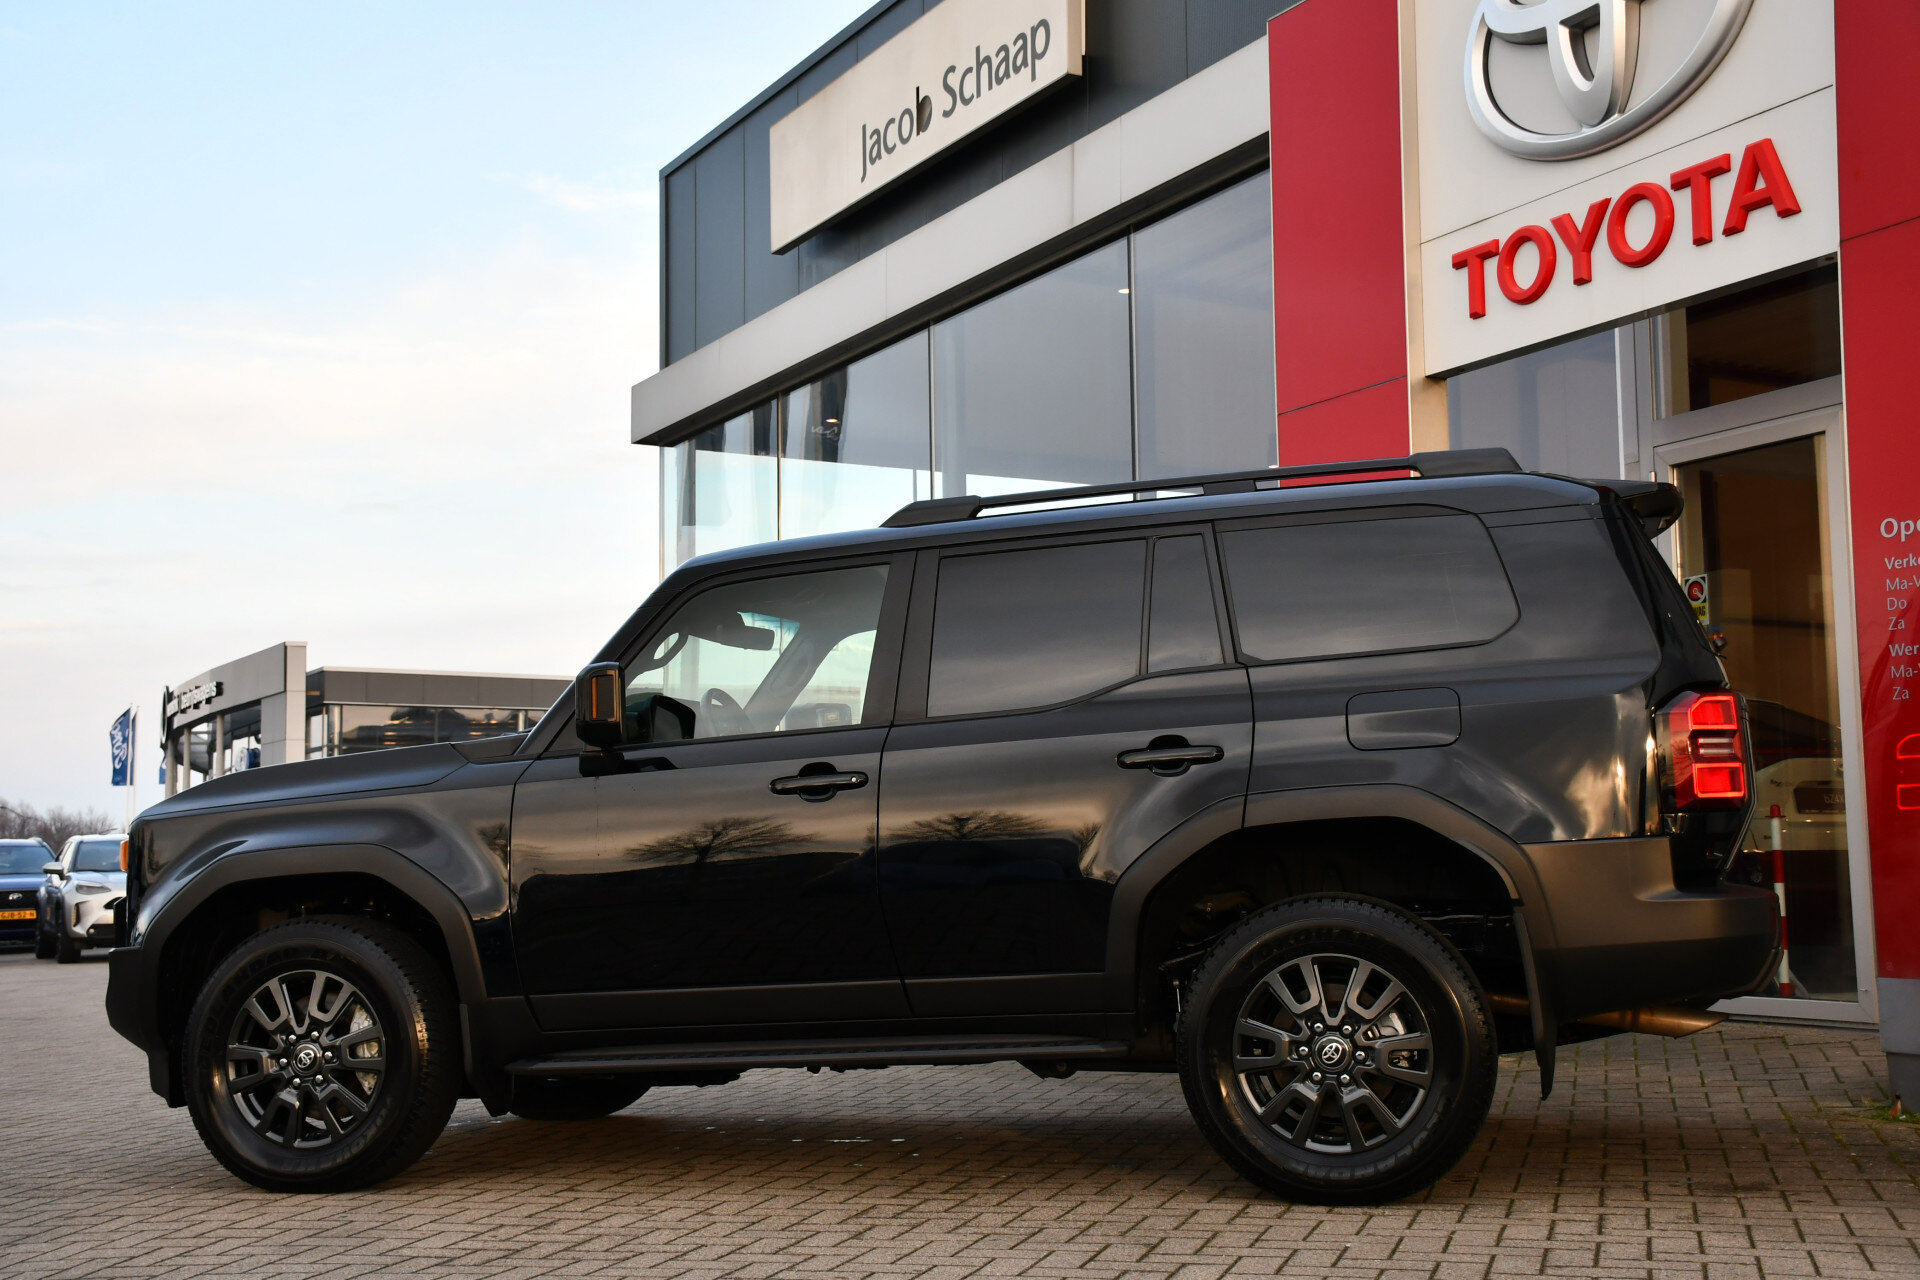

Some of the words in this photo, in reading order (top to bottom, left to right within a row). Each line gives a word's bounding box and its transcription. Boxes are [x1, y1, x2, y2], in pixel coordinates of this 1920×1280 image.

[861, 86, 933, 183] Jacob
[942, 18, 1051, 118] Schaap
[1452, 137, 1802, 320] TOYOTA
[1884, 553, 1920, 570] Verk
[1887, 597, 1907, 611] Do
[1888, 616, 1905, 631] Za
[1888, 643, 1920, 657] Wer
[1891, 663, 1920, 679] Ma-
[1893, 686, 1910, 700] Za
